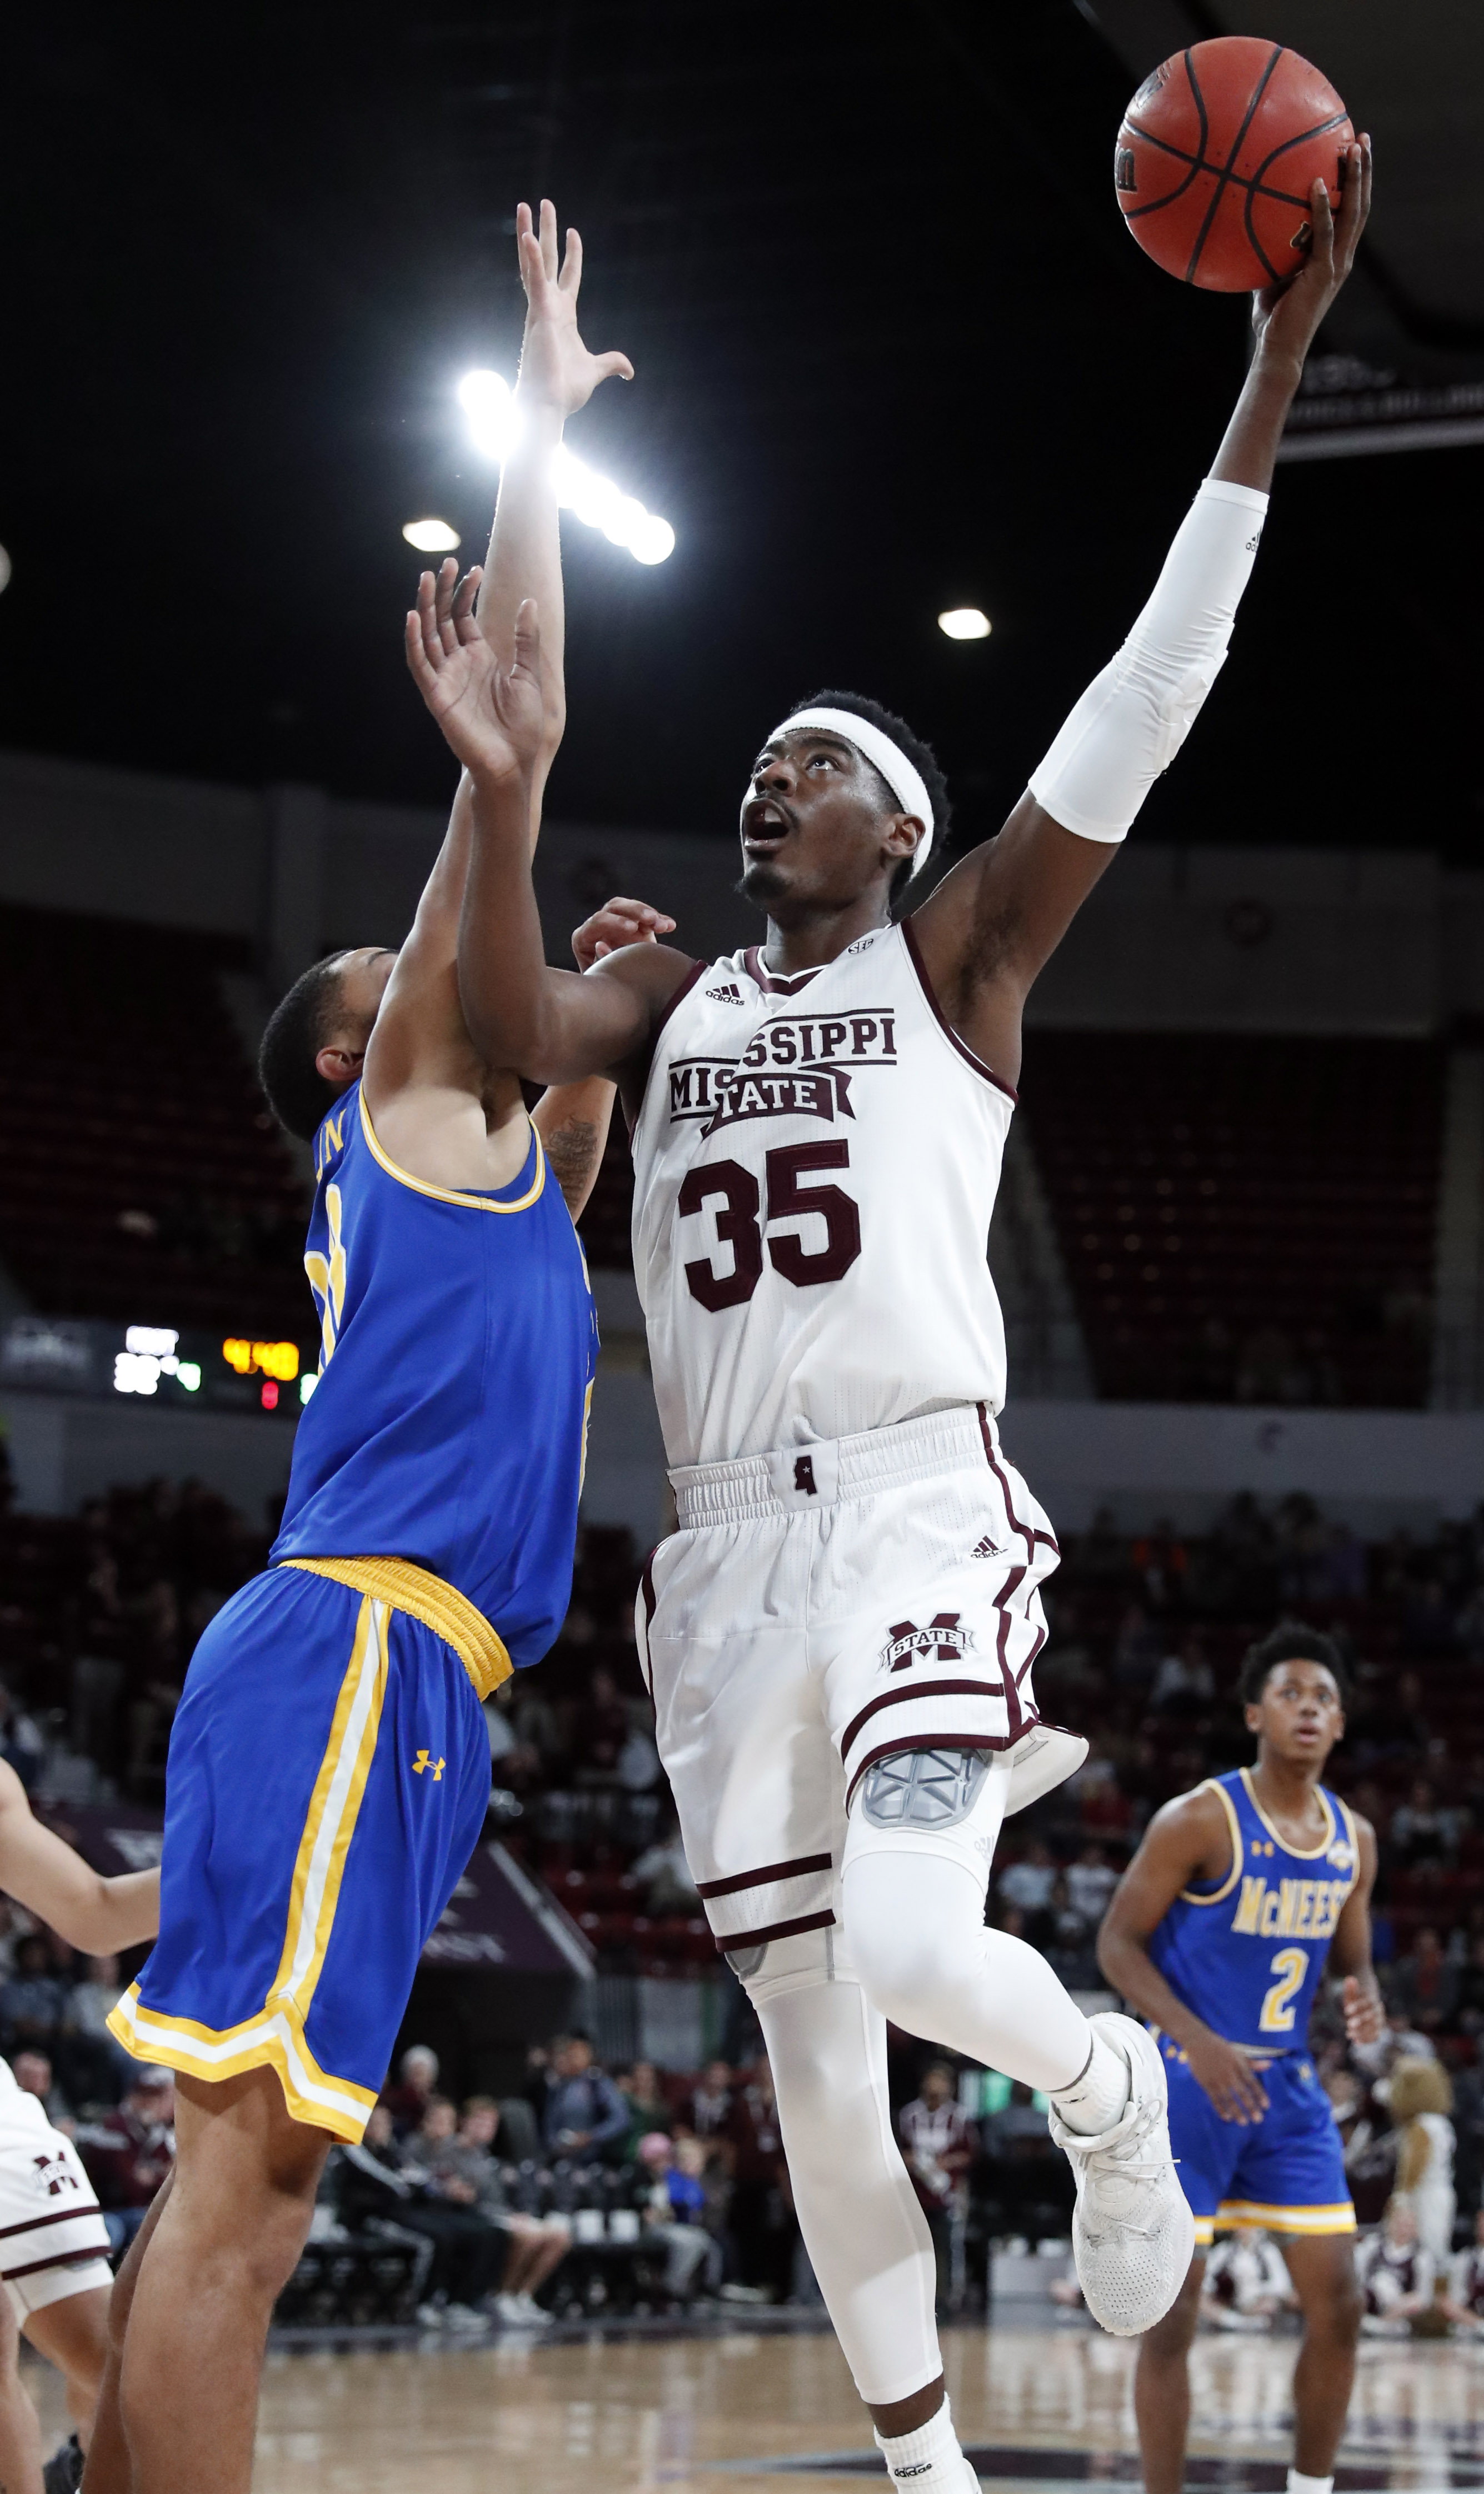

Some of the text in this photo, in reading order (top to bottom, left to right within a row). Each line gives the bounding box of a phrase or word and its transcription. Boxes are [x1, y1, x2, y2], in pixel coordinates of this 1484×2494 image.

[850, 940, 873, 954] SEC
[706, 990, 745, 1006] adidas
[678, 1138, 862, 1313] 35
[895, 1630, 957, 1656] STATE
[1258, 1946, 1310, 2032] 2
[895, 2463, 932, 2477] adidas
